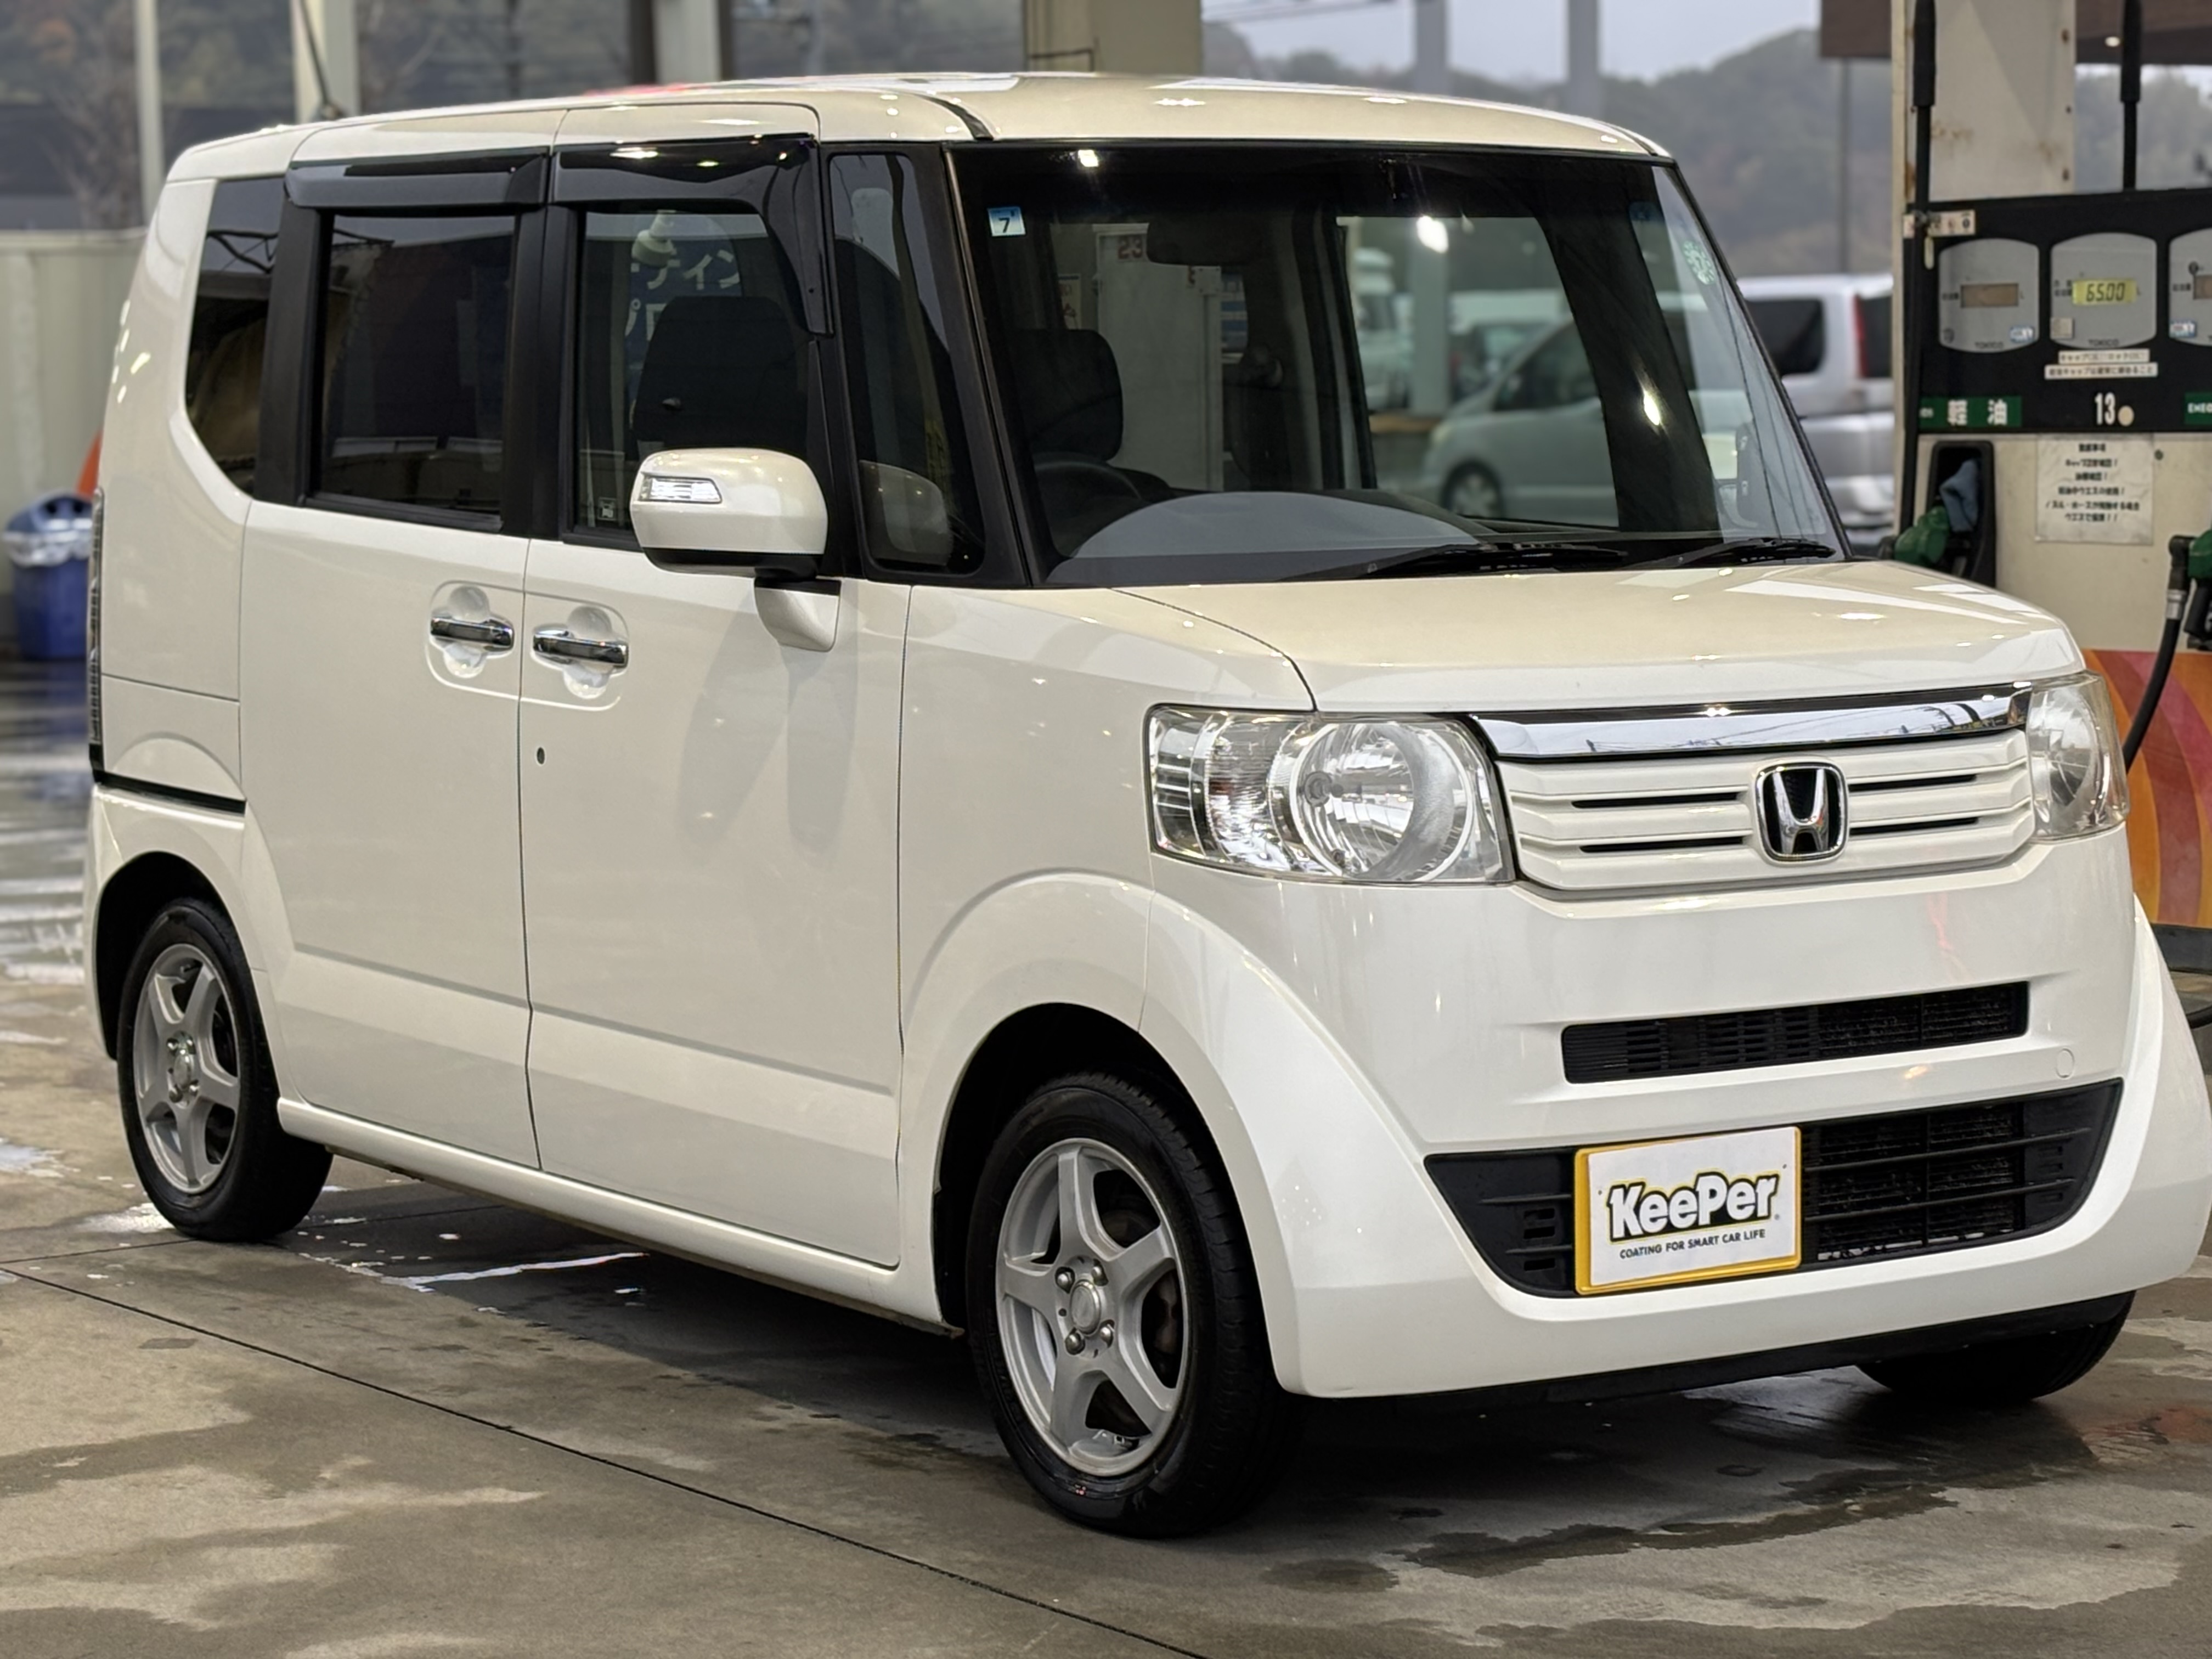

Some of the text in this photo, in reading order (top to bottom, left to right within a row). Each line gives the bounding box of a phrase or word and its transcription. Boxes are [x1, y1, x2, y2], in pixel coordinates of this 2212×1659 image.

[998, 217, 1010, 233] 7
[2095, 392, 2116, 425] 13
[1607, 1171, 1779, 1242] KeePer
[1620, 1229, 1766, 1259] COATING FOR SMART CAR LIFE
